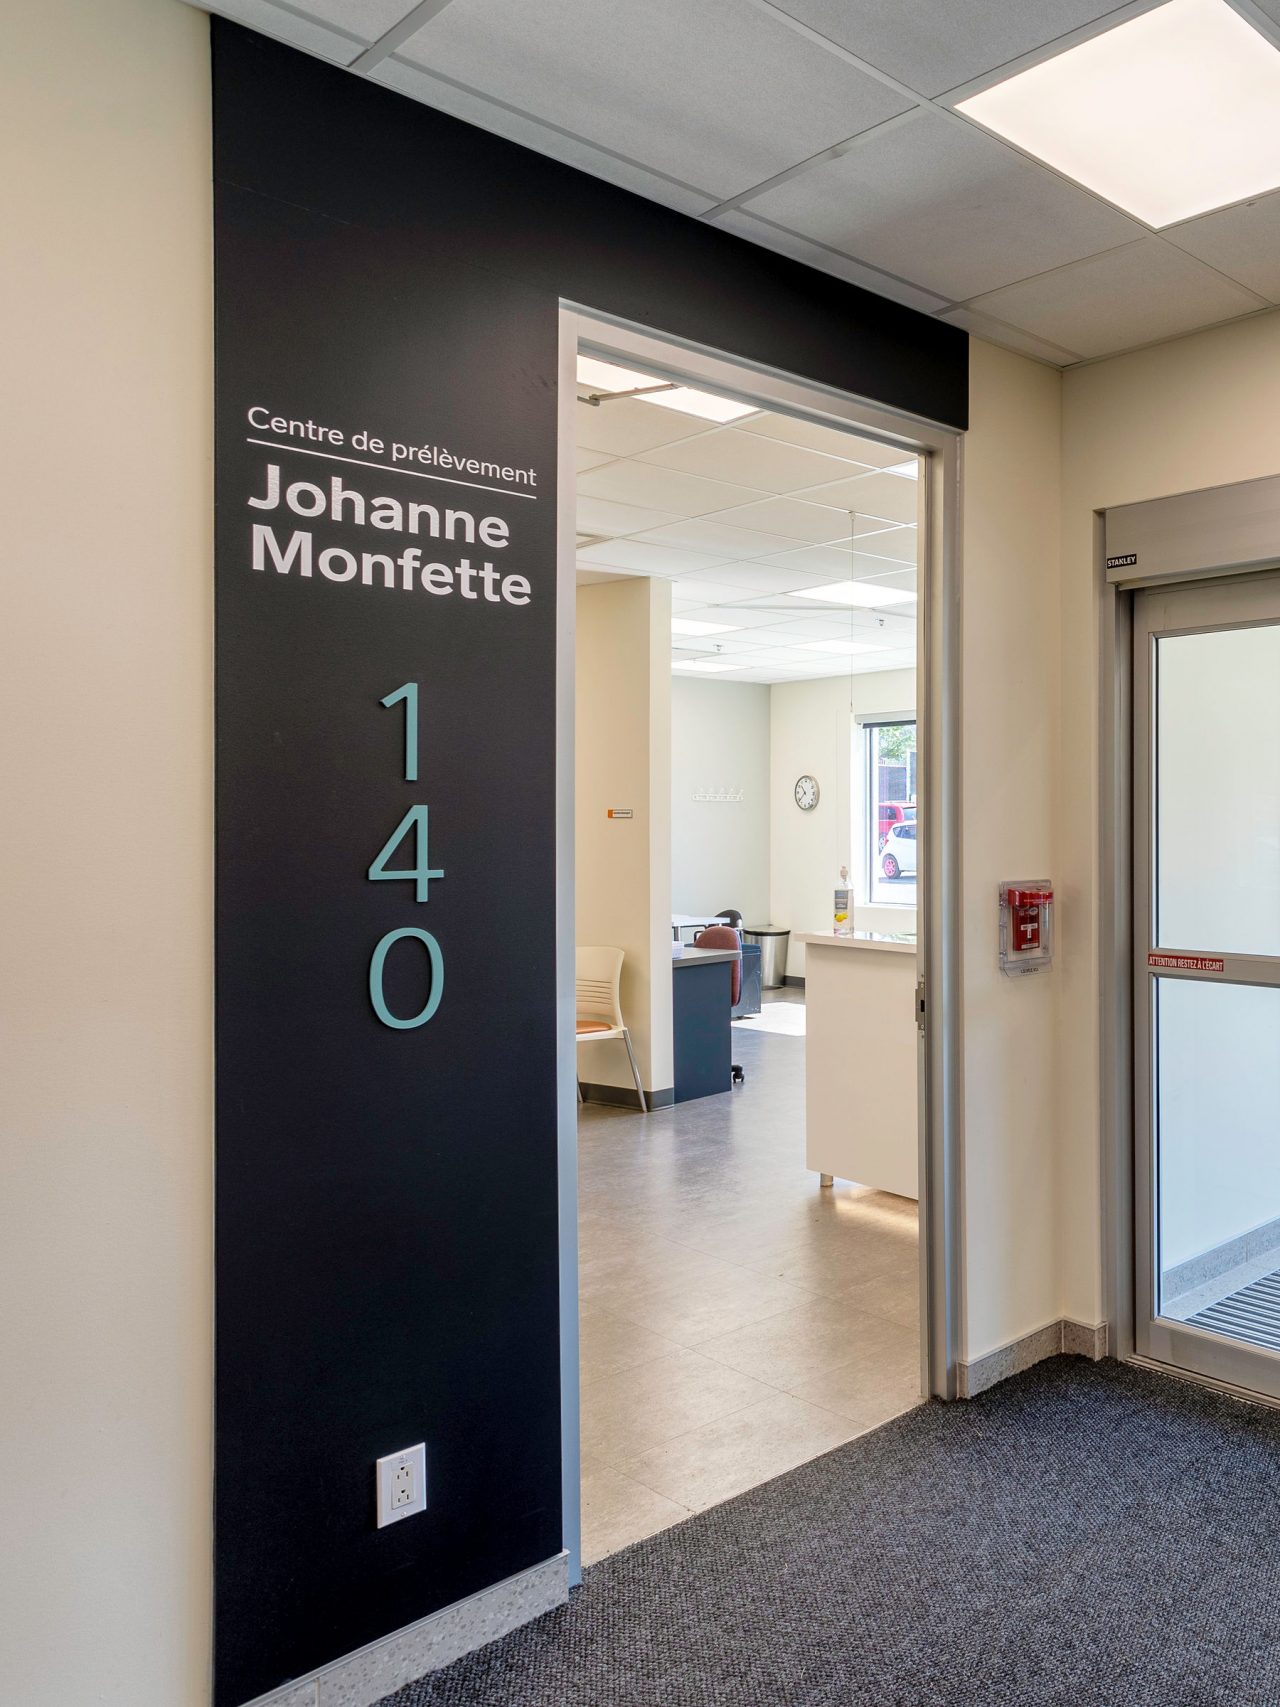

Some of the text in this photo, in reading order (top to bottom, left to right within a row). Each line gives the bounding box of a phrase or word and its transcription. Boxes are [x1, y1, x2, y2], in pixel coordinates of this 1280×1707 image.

[248, 406, 537, 486] Centre de prélèvement
[247, 463, 510, 548] Johanne
[252, 523, 531, 606] Monfette
[1107, 556, 1136, 567] STANLEY
[368, 682, 445, 1030] 140
[1149, 956, 1177, 967] ATTENTION
[1178, 958, 1196, 969] RESTEZ
[1202, 959, 1223, 971] L'ÉCART
